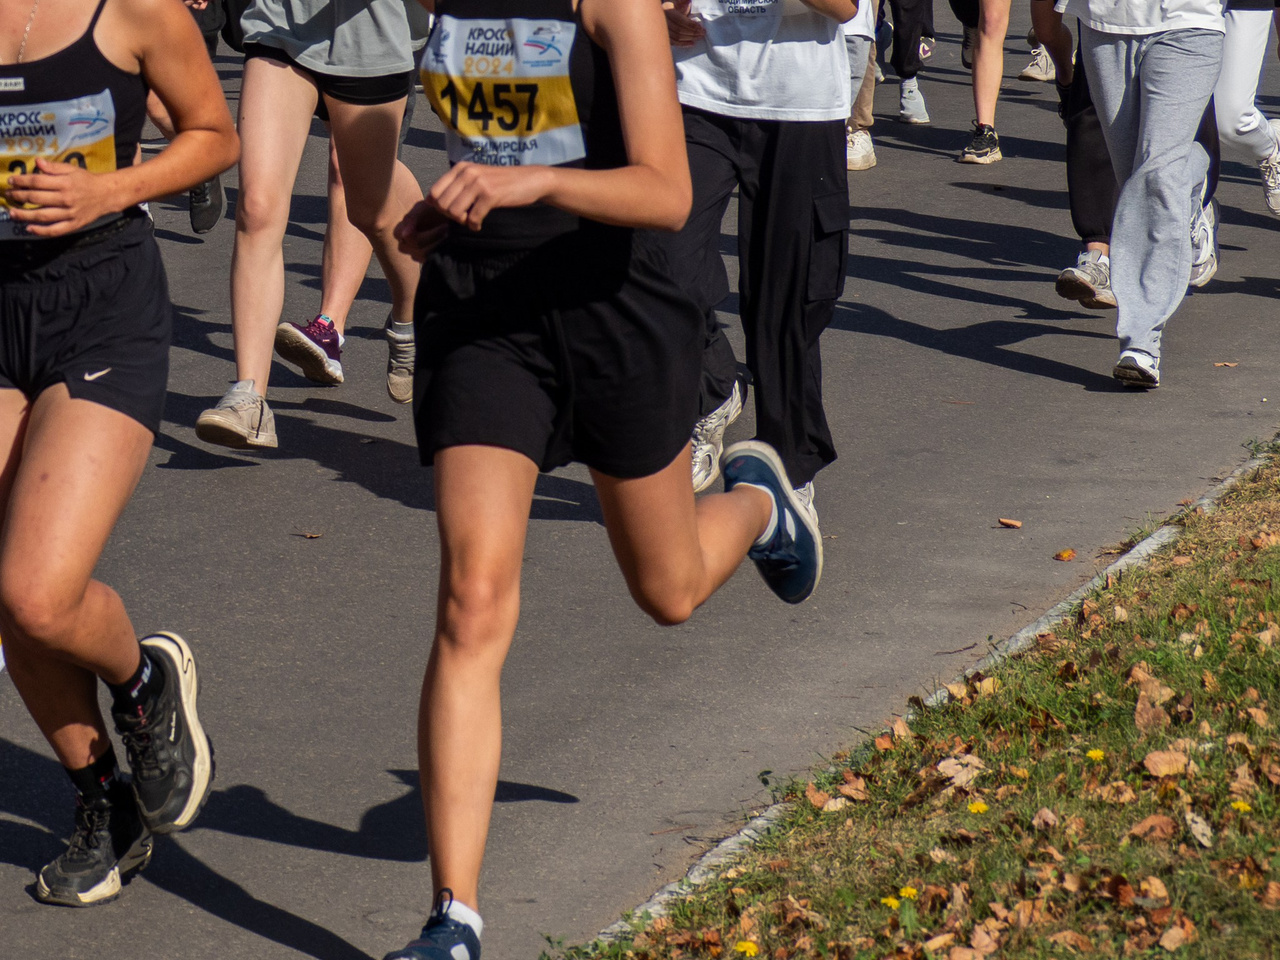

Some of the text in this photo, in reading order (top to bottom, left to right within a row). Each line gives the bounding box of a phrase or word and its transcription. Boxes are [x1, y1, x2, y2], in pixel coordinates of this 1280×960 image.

[727, 6, 767, 15] ОБЛАСТЬ
[467, 27, 507, 41] КРОСС
[464, 41, 515, 57] НАЦИИ
[463, 56, 514, 76] 2024
[440, 80, 539, 132] 1457
[0, 123, 56, 138] НАЦИИ
[7, 138, 60, 153] 2024
